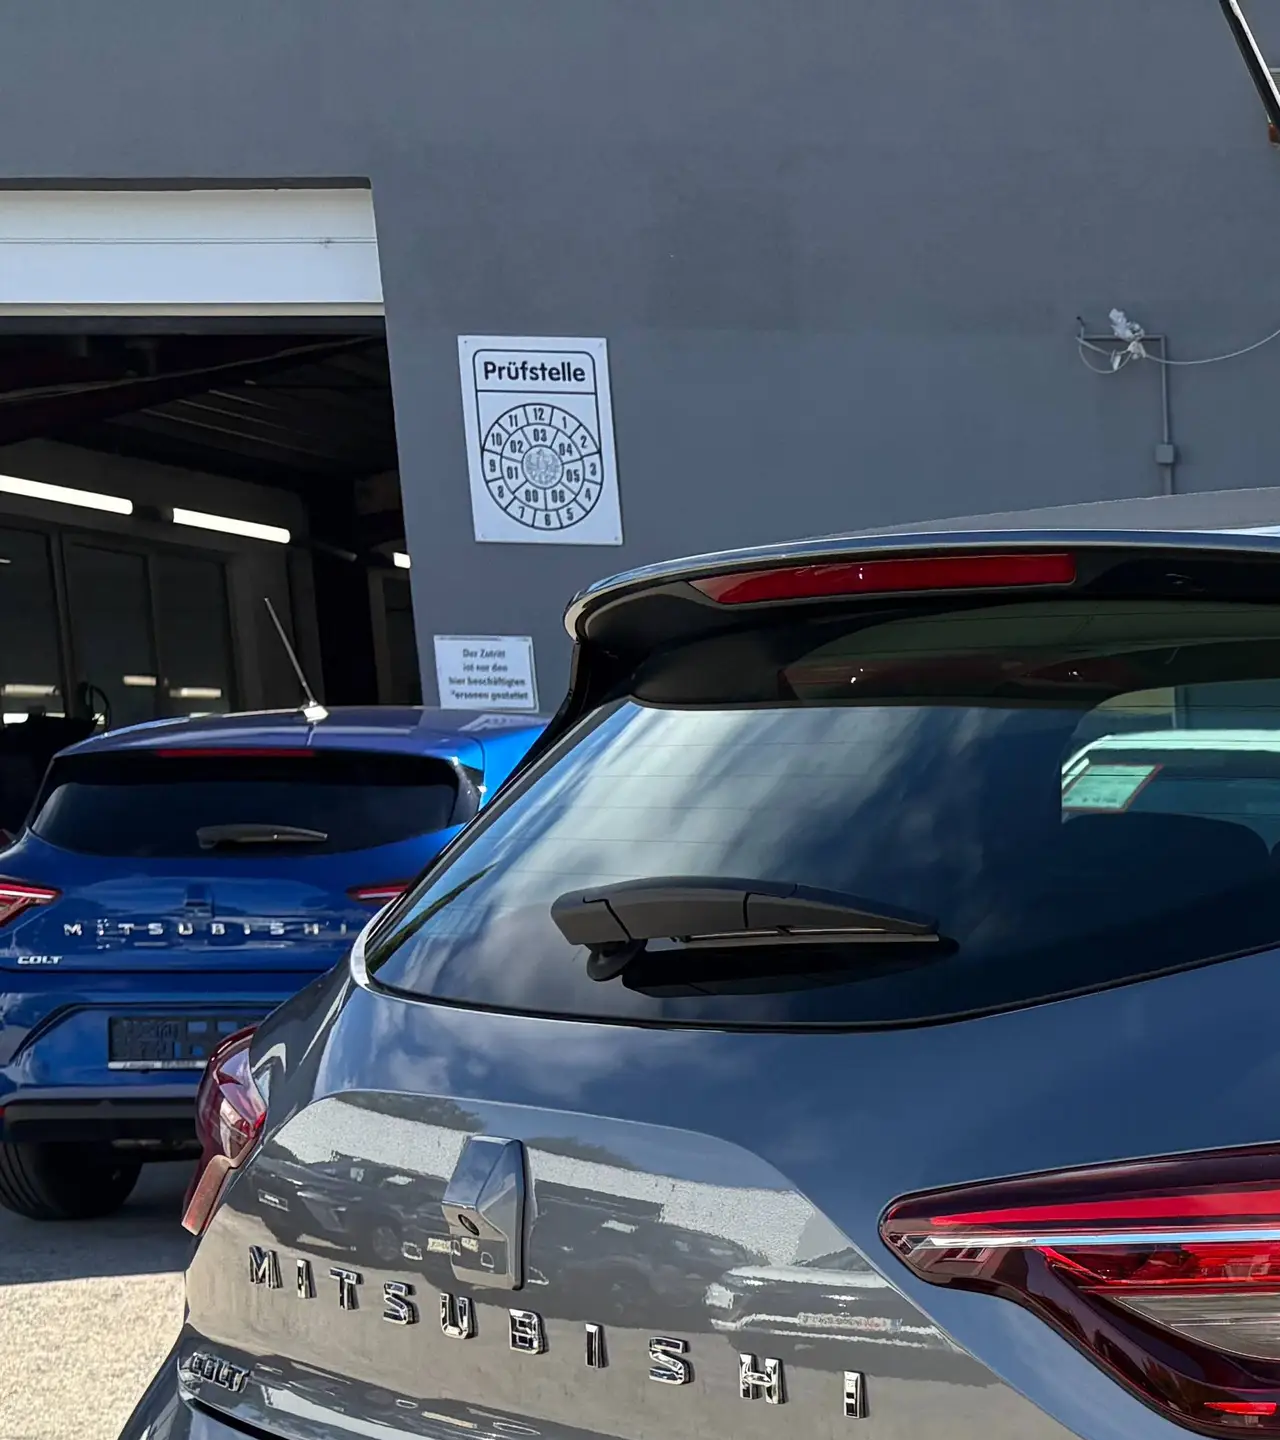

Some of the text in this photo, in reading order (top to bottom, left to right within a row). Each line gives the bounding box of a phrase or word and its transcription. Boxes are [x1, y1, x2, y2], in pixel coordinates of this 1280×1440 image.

[483, 360, 586, 382] Prüfstelle
[508, 414, 518, 428] 11
[532, 407, 545, 421] 12
[562, 416, 567, 429] 1
[491, 432, 503, 446] 10
[532, 428, 547, 442] 03
[580, 435, 588, 449] 2
[509, 439, 525, 454] 02
[558, 442, 573, 457] 04
[506, 466, 518, 480] 01
[566, 468, 580, 483] 05
[589, 462, 597, 477] 3
[585, 487, 591, 502] 4
[519, 506, 525, 519] 7
[566, 507, 574, 521] 5
[64, 922, 348, 937] MITSUBISHI
[17, 955, 63, 965] COLT
[248, 1244, 870, 1419] MITSUBISHI
